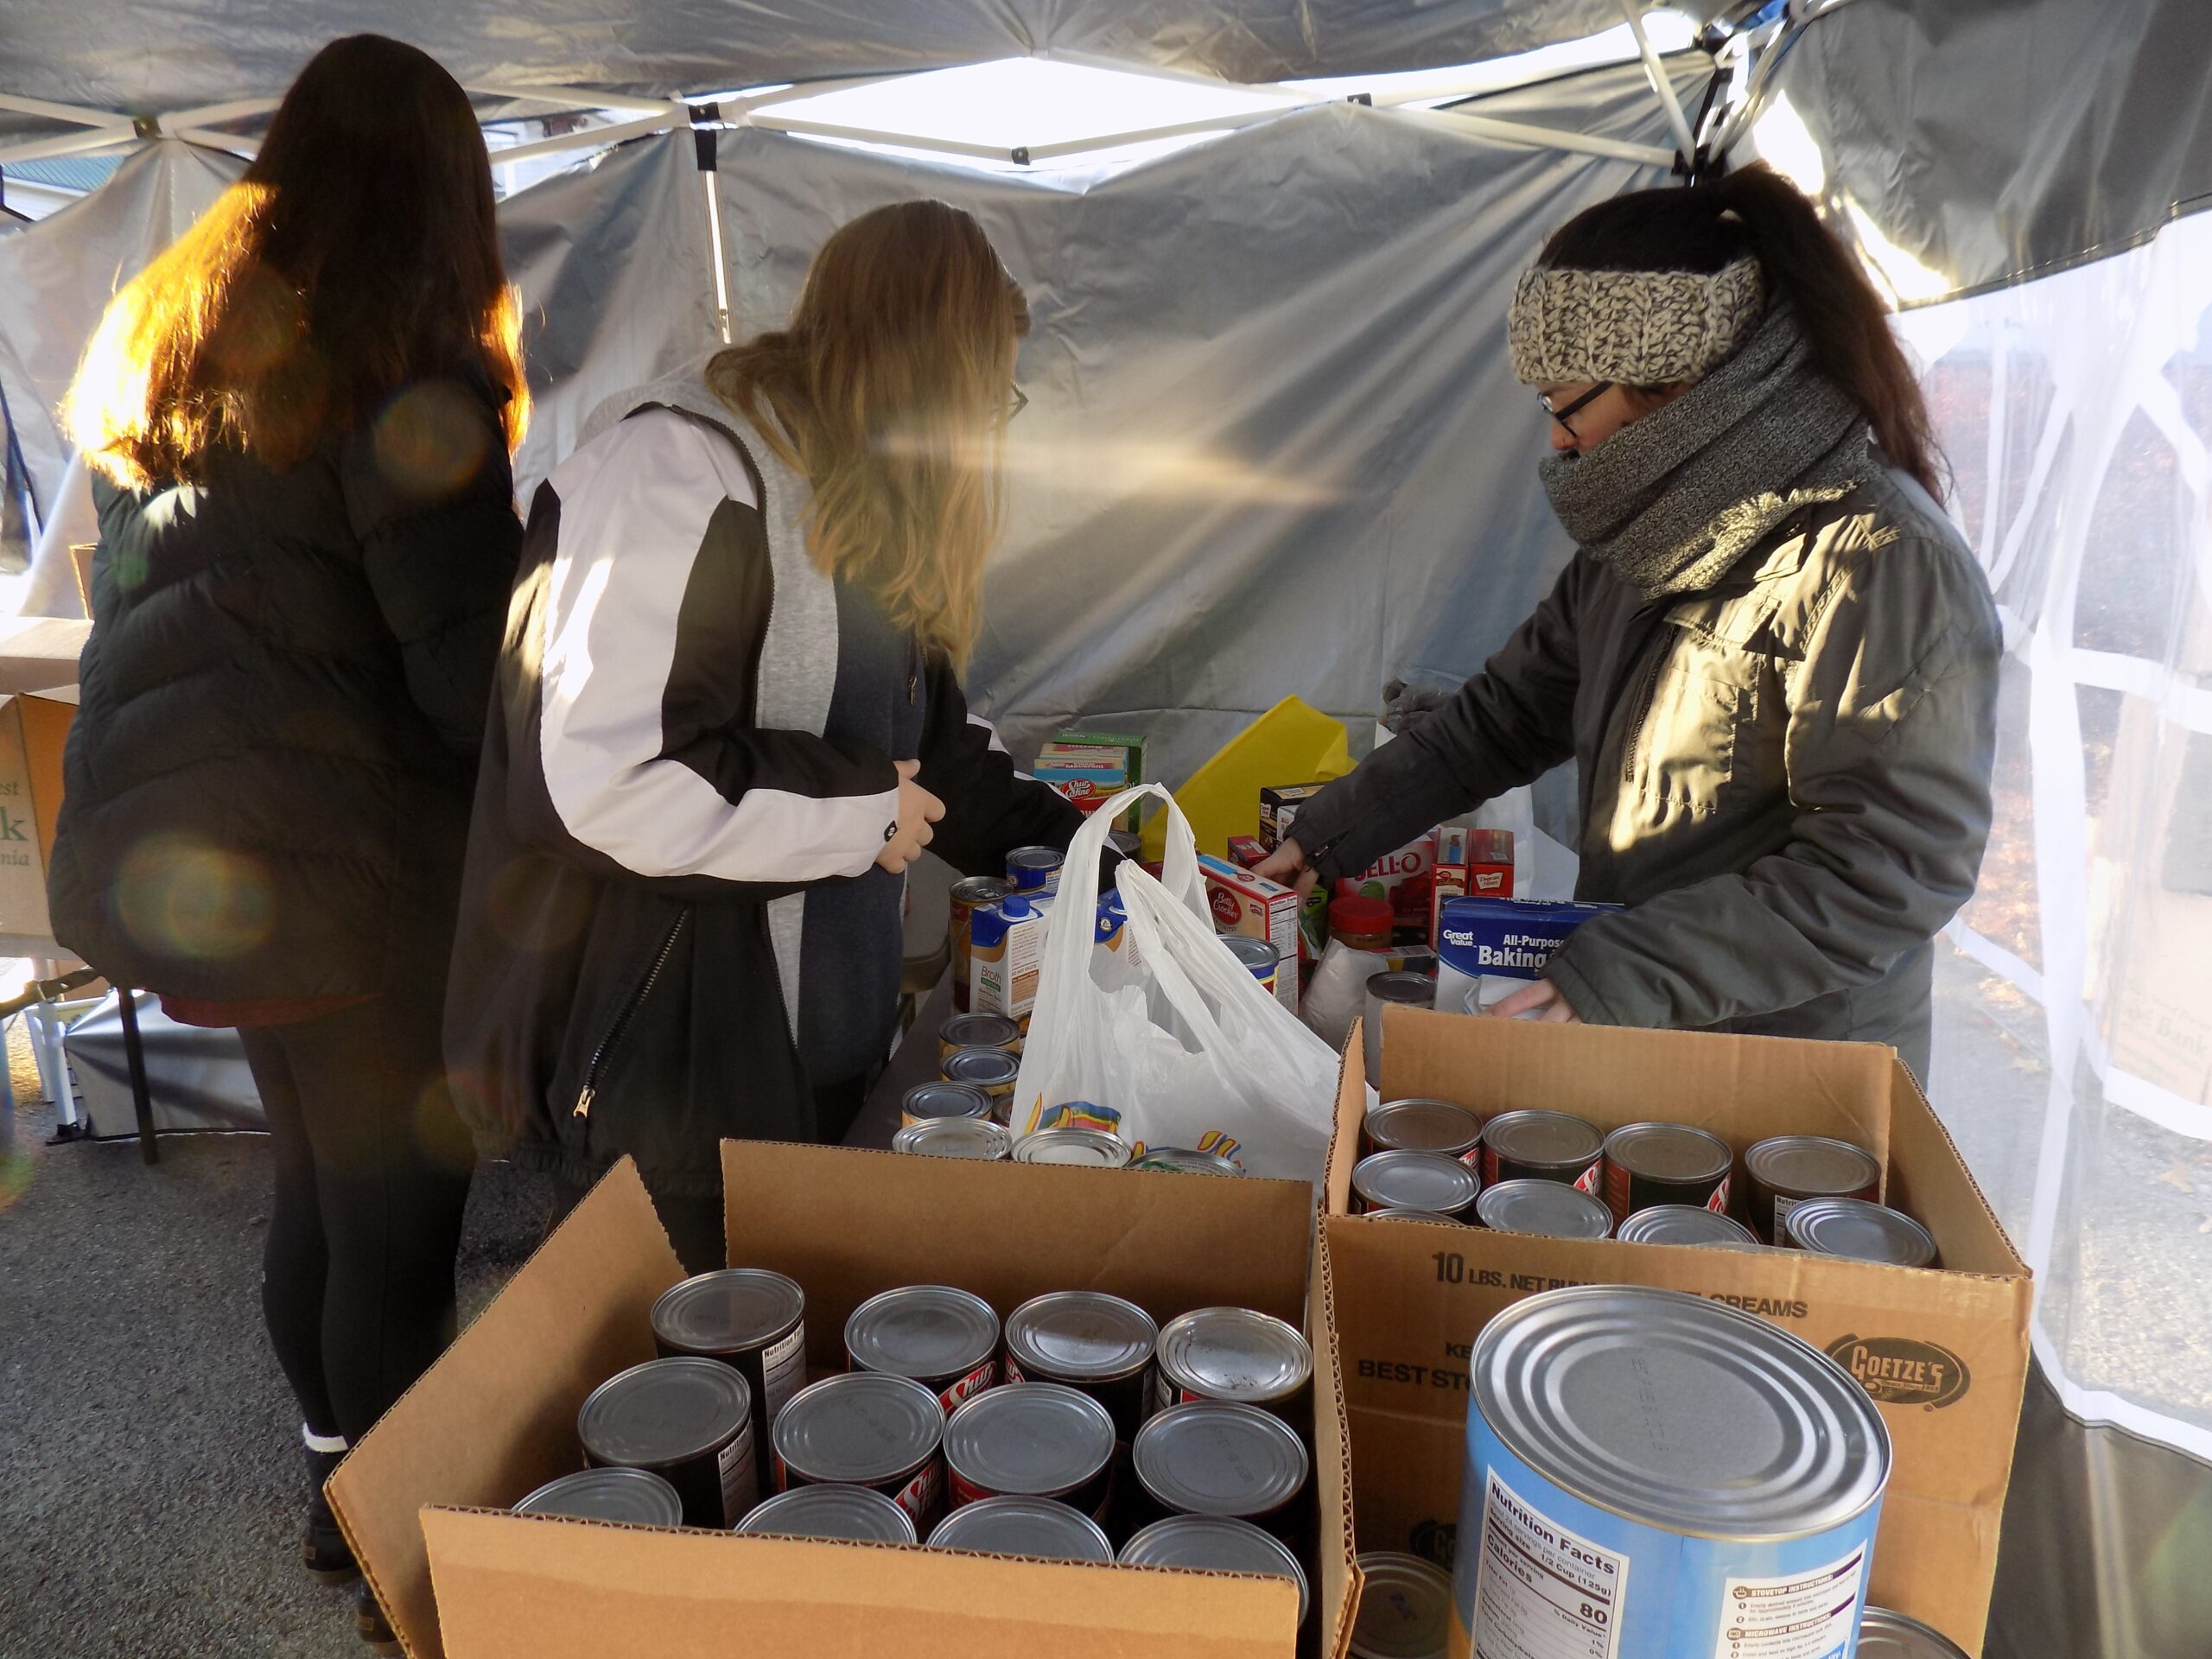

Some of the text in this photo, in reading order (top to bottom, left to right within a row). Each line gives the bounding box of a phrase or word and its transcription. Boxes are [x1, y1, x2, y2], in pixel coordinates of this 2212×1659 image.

[1213, 899, 1237, 918] Crocker
[1217, 892, 1235, 910] Betty
[1443, 929, 1473, 940] Great
[1450, 938, 1473, 947] Value
[1478, 945, 1547, 969] Baking
[982, 965, 1001, 984] Broth
[1432, 1251, 1463, 1284] 10
[1469, 1268, 1507, 1288] LBS.
[1510, 1274, 1546, 1292] NET
[764, 1338, 793, 1358] Nutrition
[1358, 1359, 1428, 1382] BEST
[1851, 1345, 1944, 1393] GOETZE'S
[1491, 1481, 1554, 1545] Nutrition
[1560, 1537, 1614, 1574] Facts
[1487, 1533, 1533, 1583] Calories
[1557, 1555, 1596, 1580] container
[1541, 1554, 1554, 1567] 1/2
[1556, 1563, 1575, 1579] Cup
[1578, 1575, 1611, 1597] (125g)
[1751, 1573, 1834, 1598] STOVETOP INSTRUCTIONS:
[1580, 1602, 1608, 1624] 80
[1745, 1625, 1788, 1637] MICROWAVE
[1788, 1612, 1831, 1633] INSTRUCTIONS:
